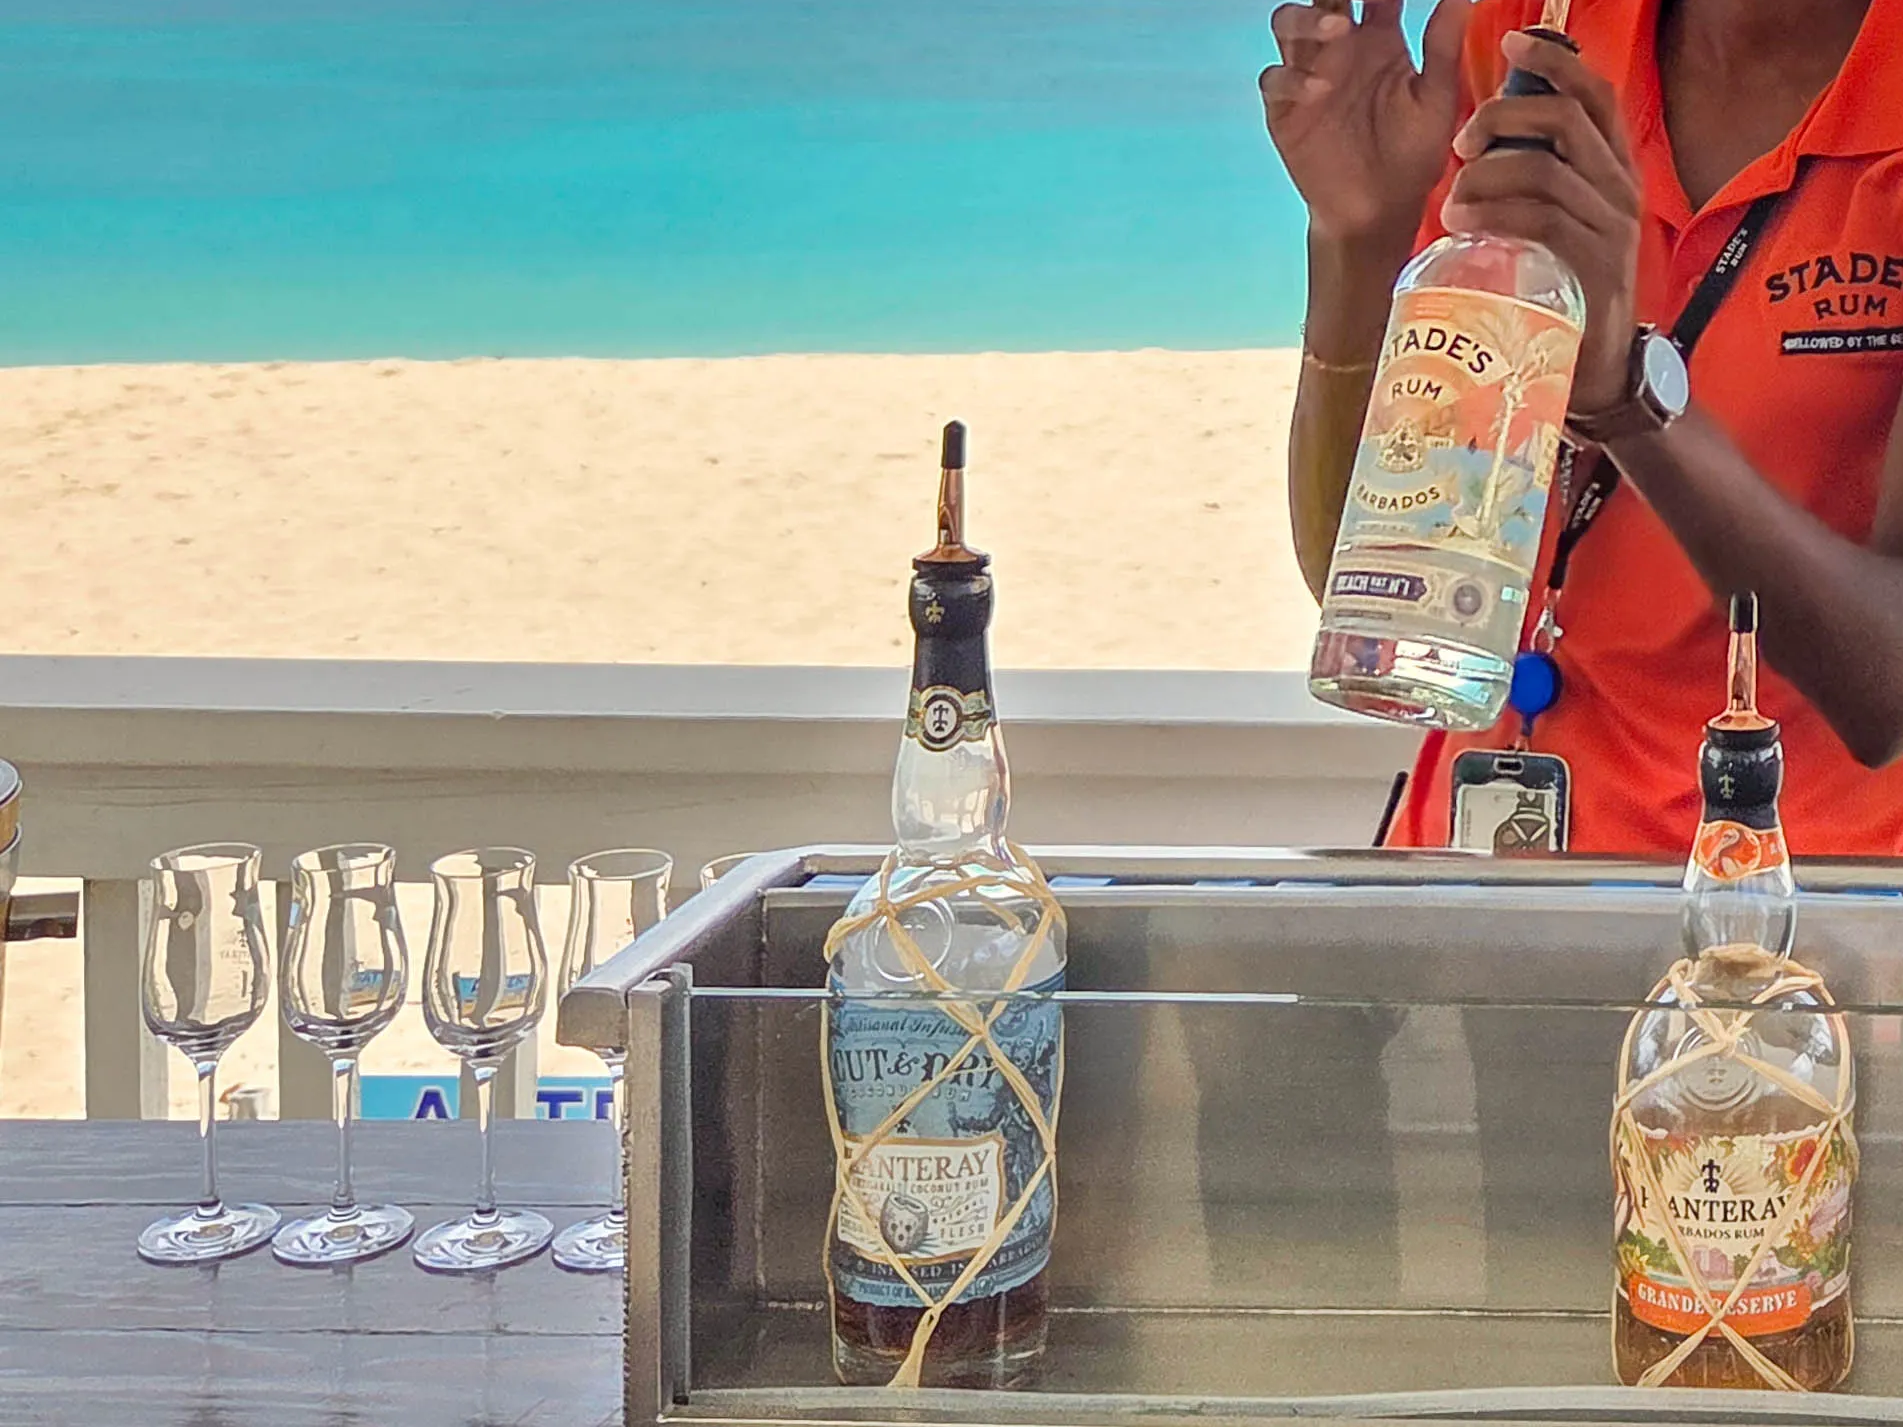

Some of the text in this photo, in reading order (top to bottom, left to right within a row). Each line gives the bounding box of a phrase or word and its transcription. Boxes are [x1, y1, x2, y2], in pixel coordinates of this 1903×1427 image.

[1813, 294, 1889, 320] RUM
[1866, 334, 1888, 347] THE
[1392, 378, 1443, 401] RUM
[1641, 1185, 1787, 1223] ANTERA
[1677, 1224, 1765, 1239] RBADOS RUM
[1637, 1283, 1705, 1315] GRANDE
